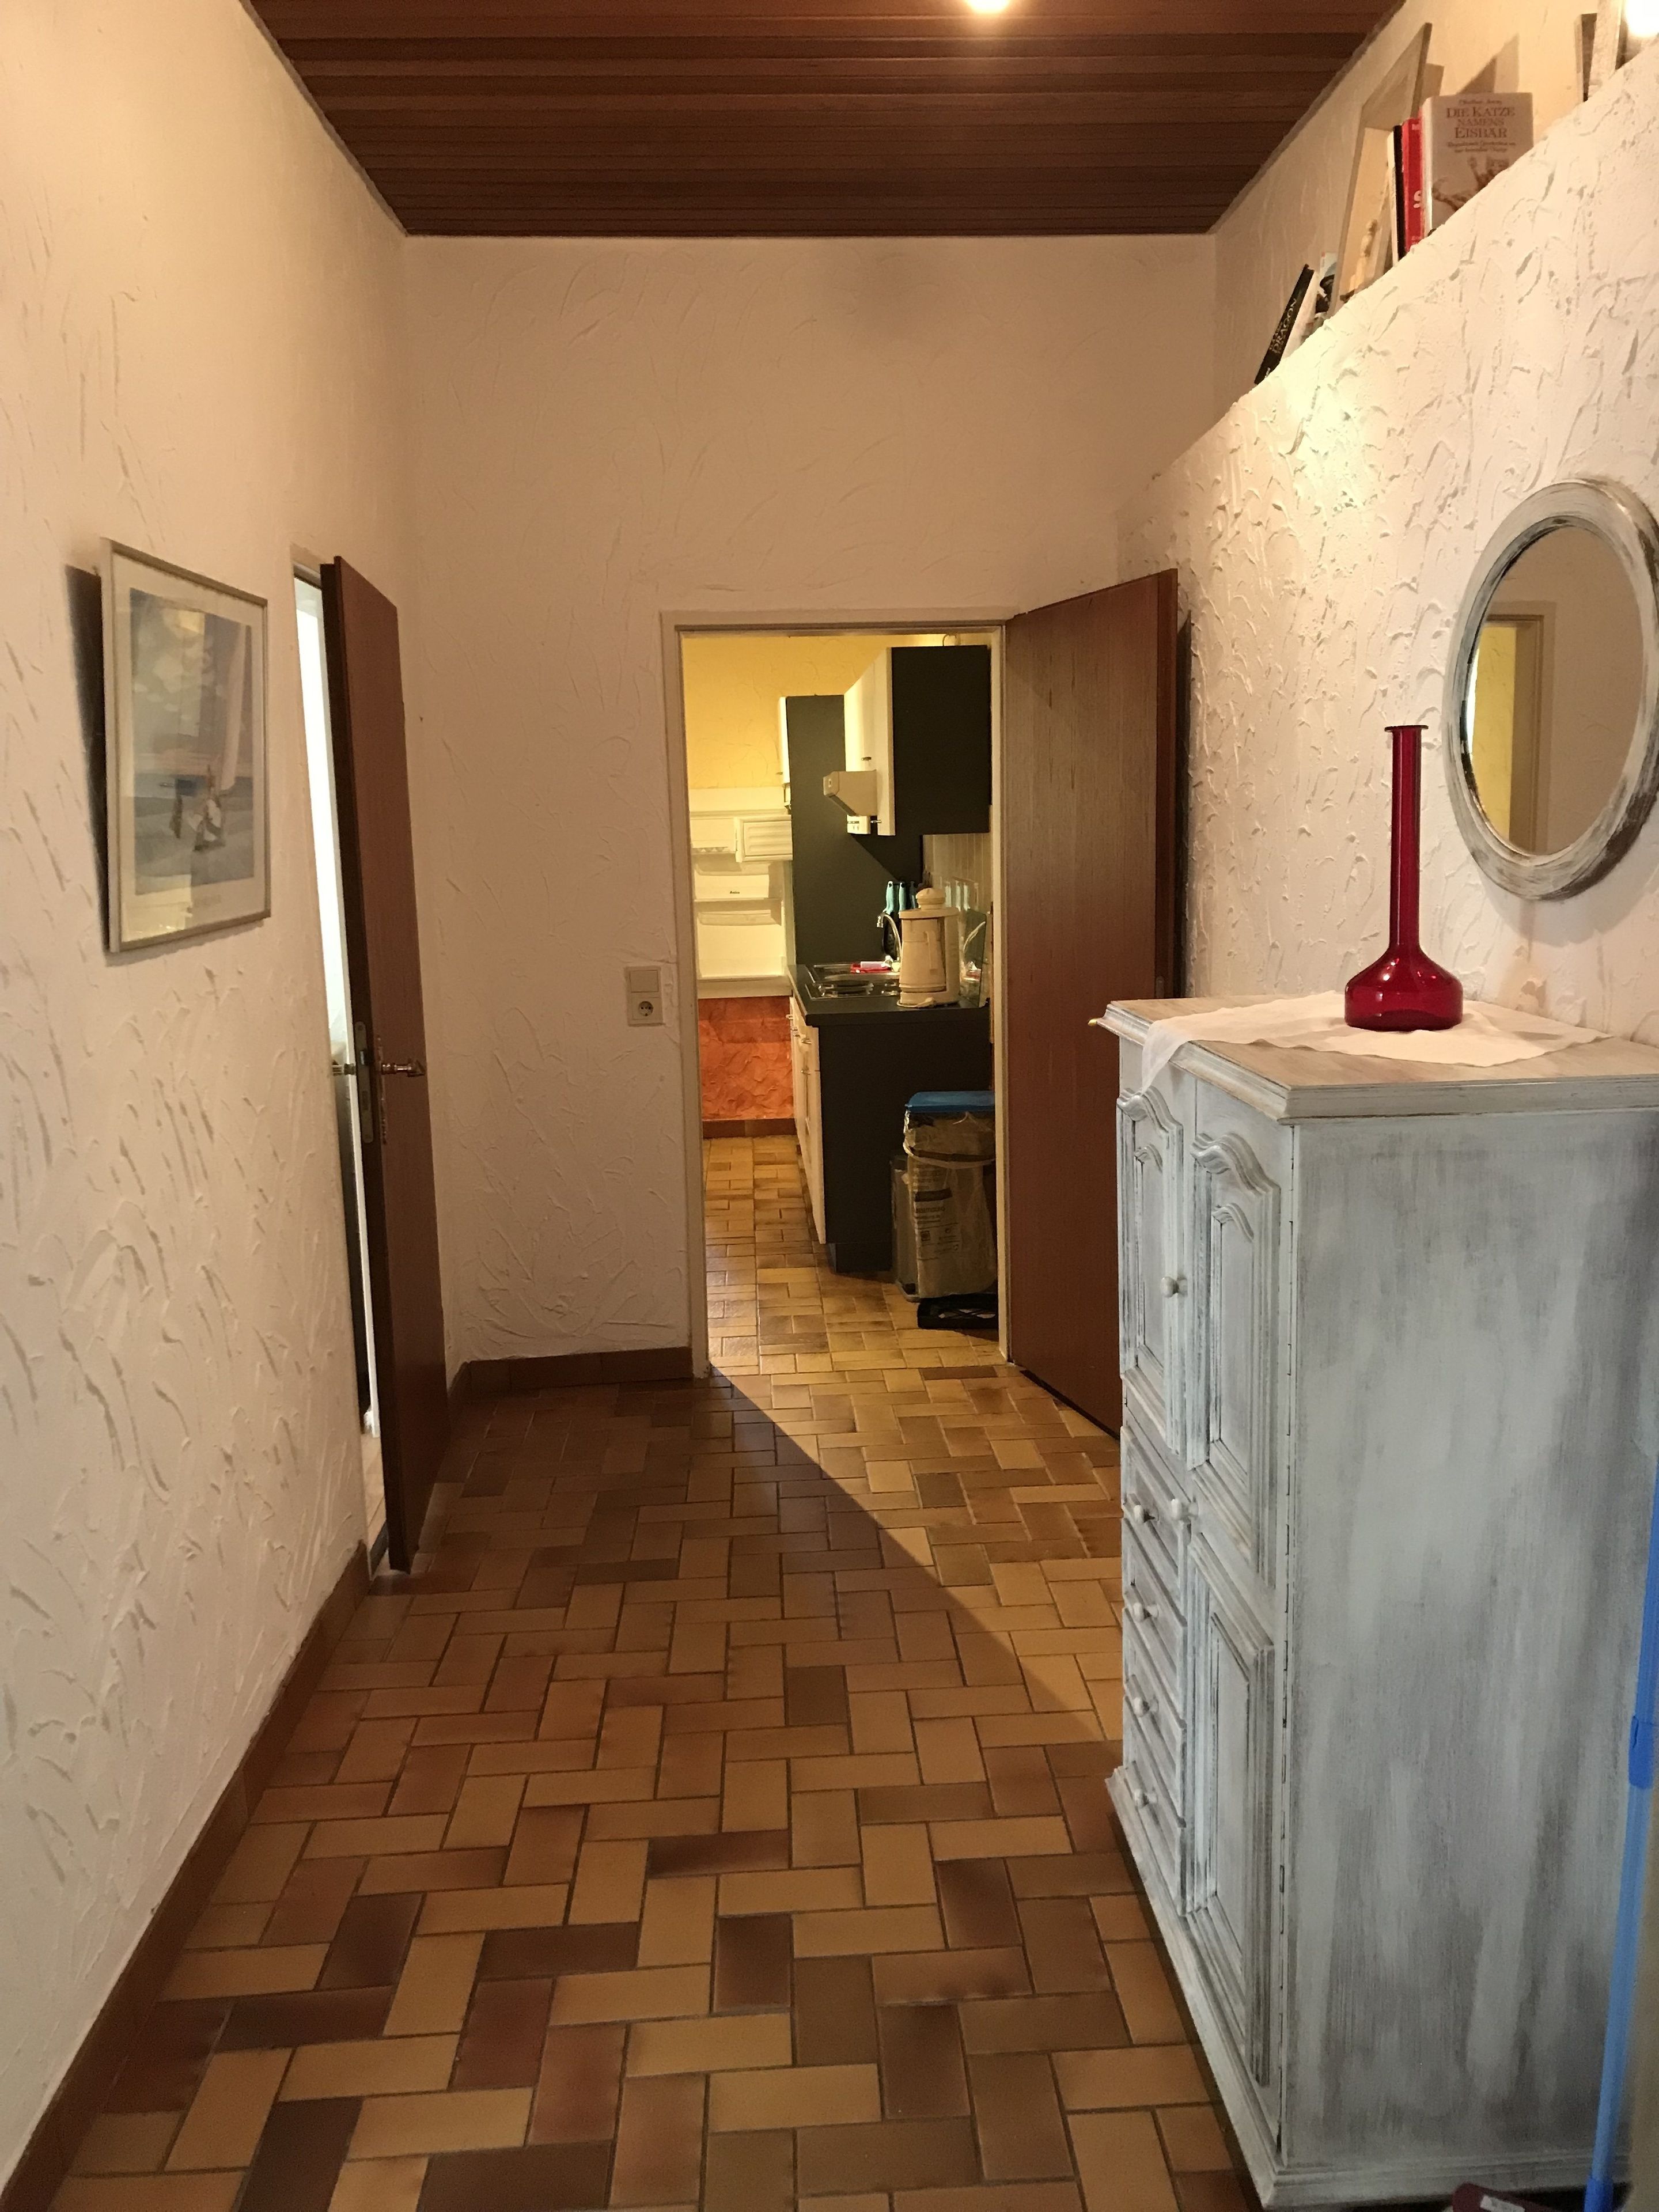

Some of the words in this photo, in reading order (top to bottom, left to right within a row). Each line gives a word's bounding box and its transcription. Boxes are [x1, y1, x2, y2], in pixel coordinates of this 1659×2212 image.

[1446, 107, 1471, 118] DIE
[1472, 106, 1516, 117] KATZE
[1457, 117, 1505, 127] NAMENS
